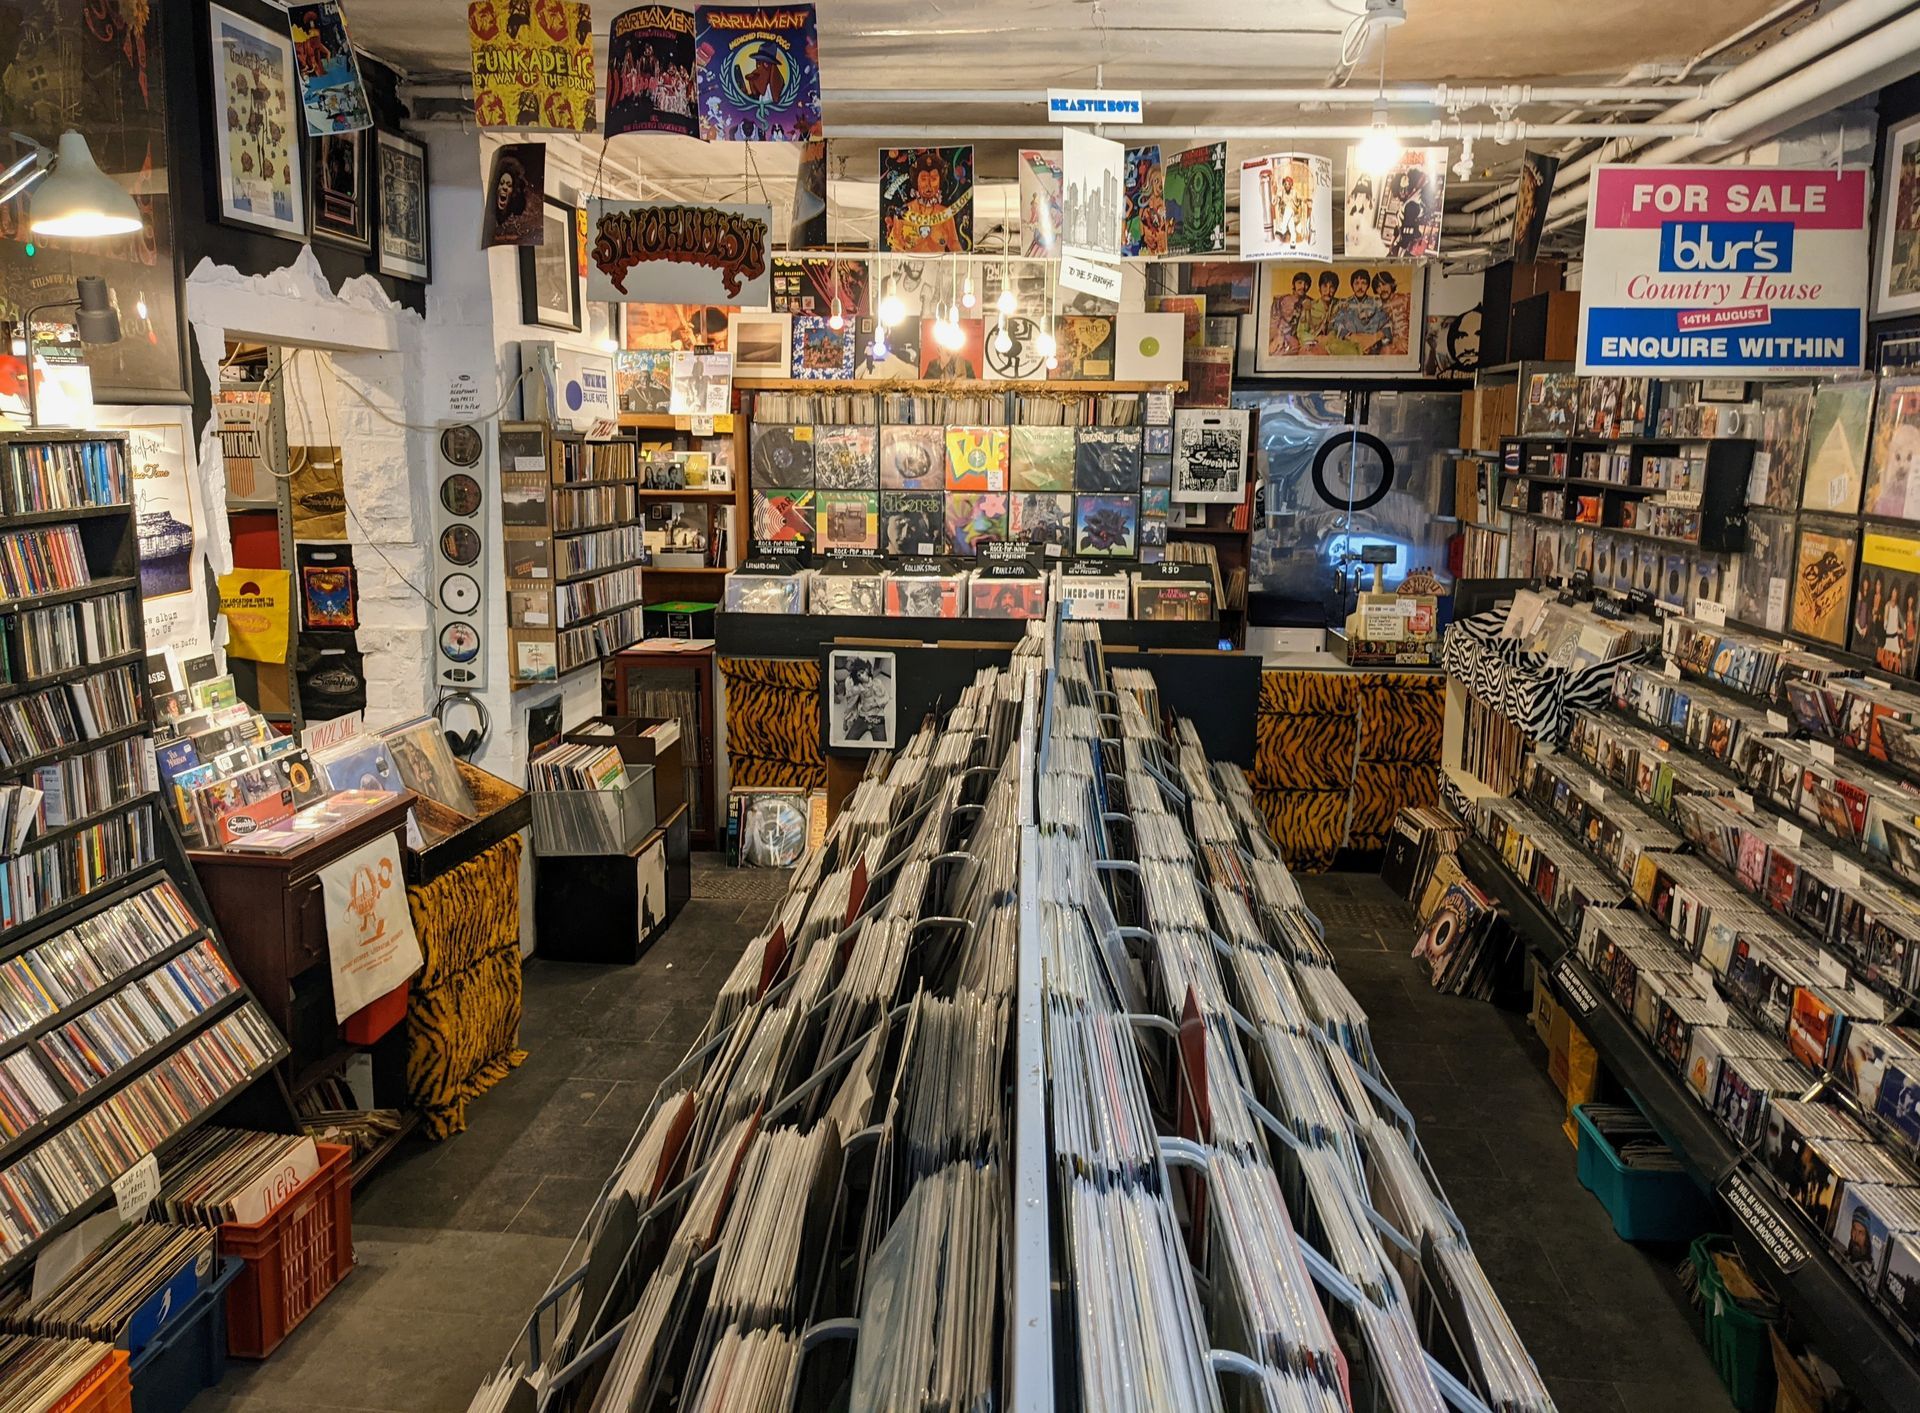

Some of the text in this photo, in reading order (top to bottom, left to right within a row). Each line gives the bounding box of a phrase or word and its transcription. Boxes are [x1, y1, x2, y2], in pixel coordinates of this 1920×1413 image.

[616, 8, 697, 38] PARLIAMEN
[706, 11, 809, 29] PARLIAMENT
[472, 50, 593, 76] FUNKADELIC
[475, 73, 596, 92] BY WAY OF THE DRUM
[1051, 98, 1139, 113] BEASTIE BOYS
[1632, 184, 1826, 213] FOR SALE
[1673, 224, 1779, 270] blur's
[1627, 274, 1822, 305] Country House
[1682, 310, 1763, 325] 14TH AUGUST
[1601, 337, 1844, 360] ENQUIRE WITHIN
[583, 392, 608, 404] BLUE NOTE
[219, 431, 261, 458] CHICAGO
[144, 611, 178, 626] ew album
[152, 627, 161, 637] To
[311, 673, 357, 689] Swordfish
[311, 717, 355, 750] VINYL SALE
[1727, 1189, 1791, 1265] SCRATCHED OR BROKEN CASES
[1730, 1174, 1805, 1264] WE WILL BE HAPPY TO REPLACE ANY
